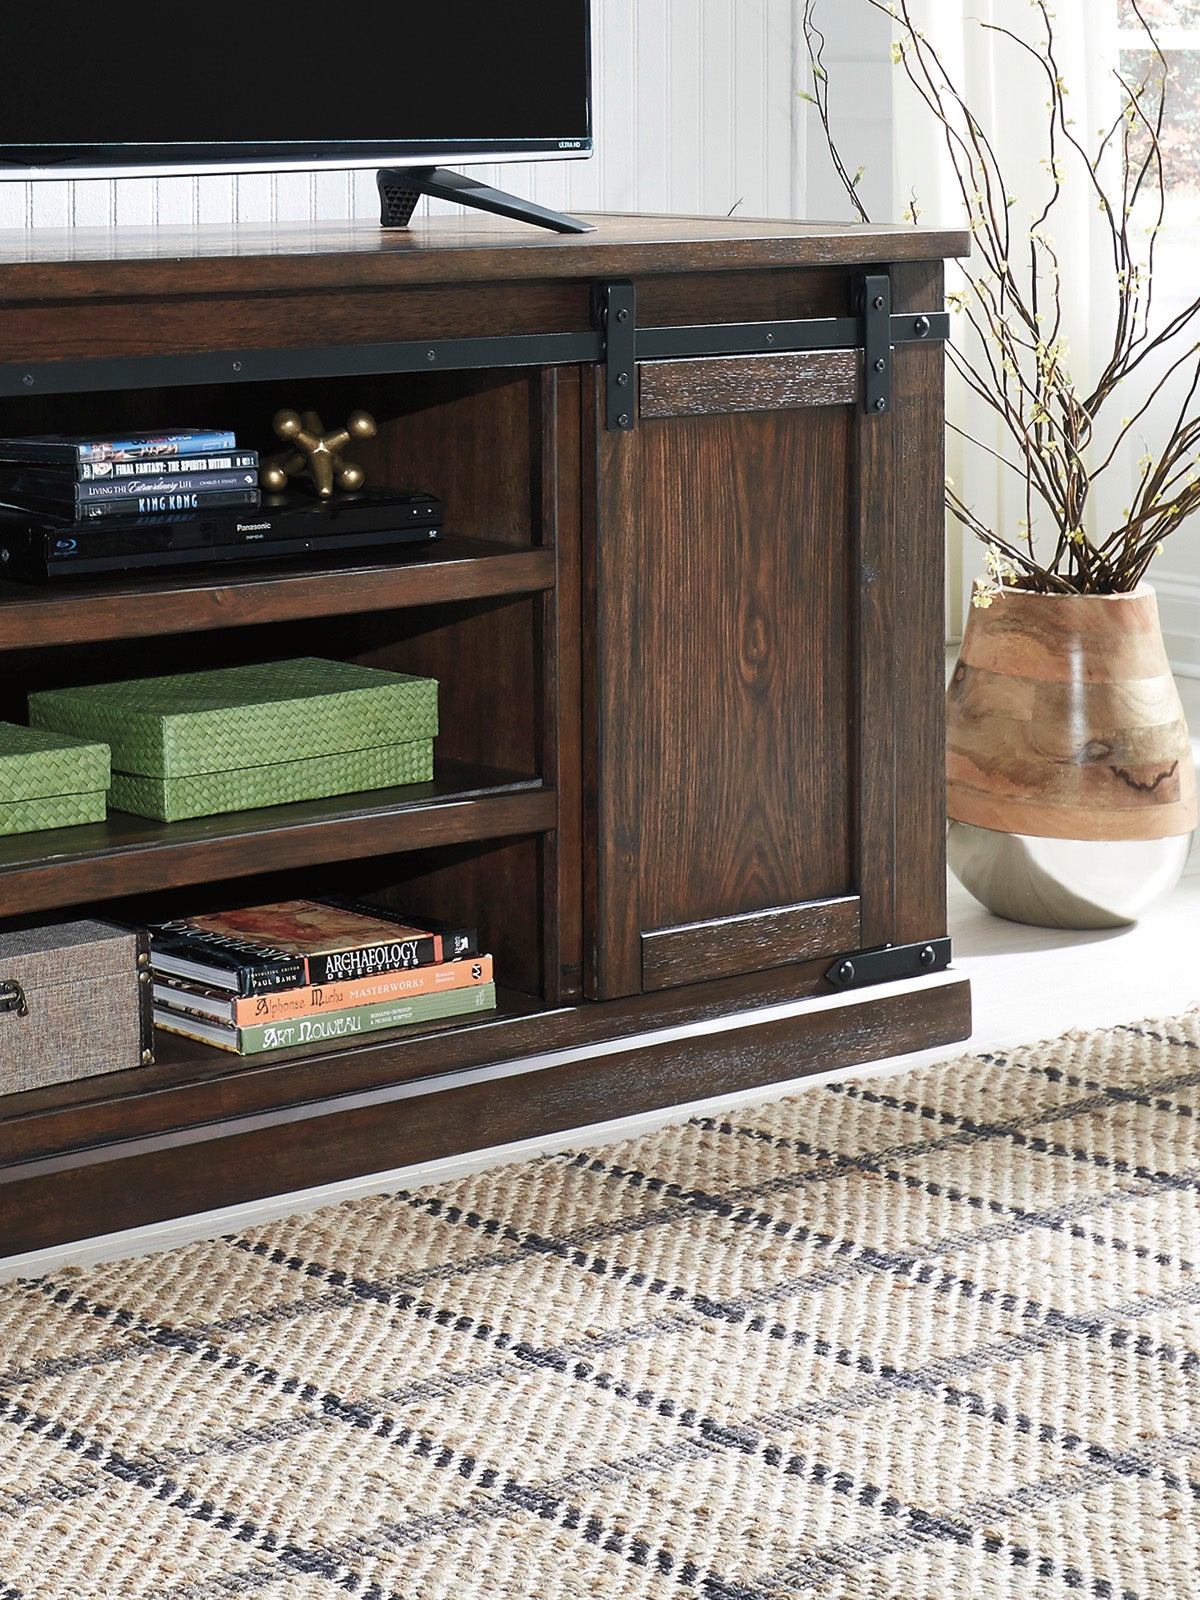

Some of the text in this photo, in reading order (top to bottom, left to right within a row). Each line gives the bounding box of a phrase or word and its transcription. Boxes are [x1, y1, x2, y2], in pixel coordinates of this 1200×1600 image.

[115, 463, 135, 475] FINAL
[136, 461, 167, 475] FANTASY:
[167, 461, 180, 473] THE
[181, 459, 207, 472] SPIRITS
[208, 457, 232, 470] WITHIN
[88, 485, 113, 496] LIVING
[114, 485, 127, 494] THE
[179, 480, 192, 489] LIFE
[139, 494, 198, 513] KING KONG
[236, 521, 272, 532] Panasonic
[325, 941, 418, 974] ARCHAEOLOGY
[281, 965, 300, 973] EDITOR
[327, 958, 419, 980] DETECTIVES
[252, 974, 297, 988] PAUL BAHN
[255, 978, 424, 1018] Alphonse Mucha MASTERWORKS
[262, 1015, 361, 1049] ART NOUVEAU
